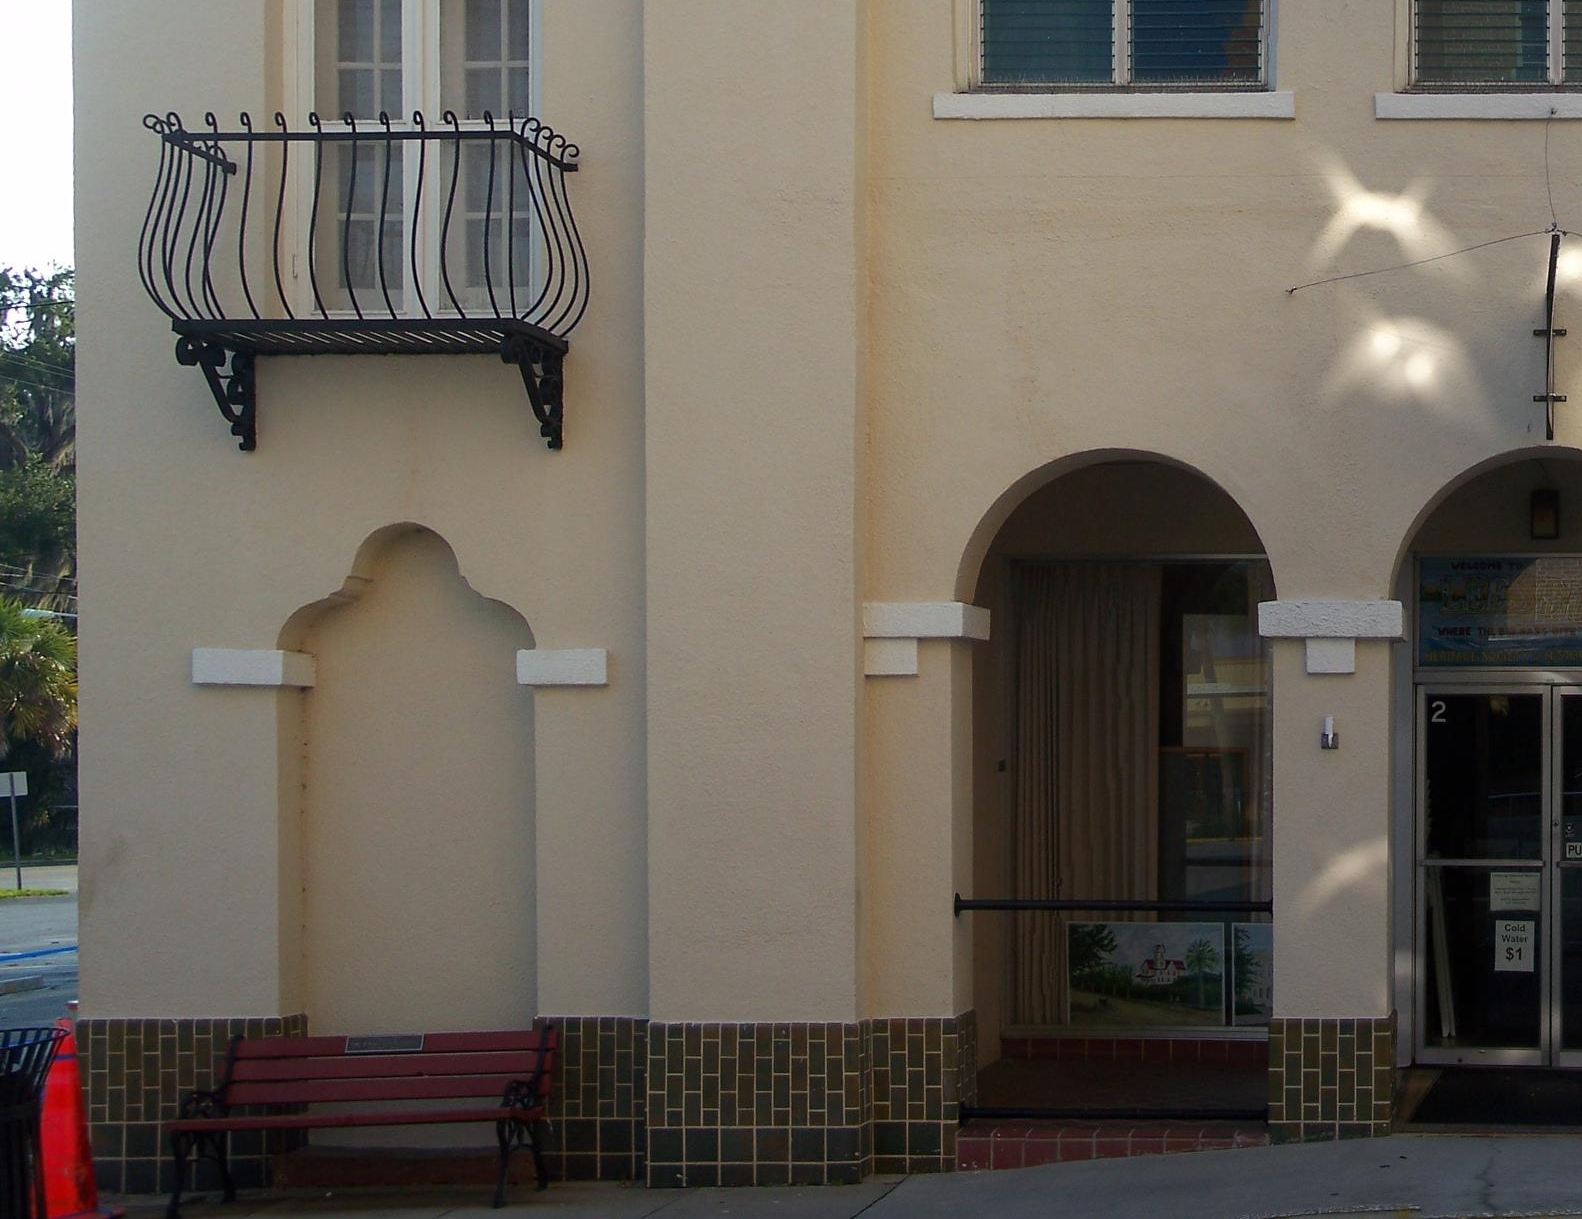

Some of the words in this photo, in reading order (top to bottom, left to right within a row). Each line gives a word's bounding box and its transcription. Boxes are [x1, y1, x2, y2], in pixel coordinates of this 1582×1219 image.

[1450, 561, 1502, 571] WELCOME
[1508, 562, 1523, 571] TO
[1431, 700, 1447, 723] 2
[1504, 923, 1526, 932] Cold
[1501, 934, 1529, 943] Water
[1505, 946, 1523, 962] $1
